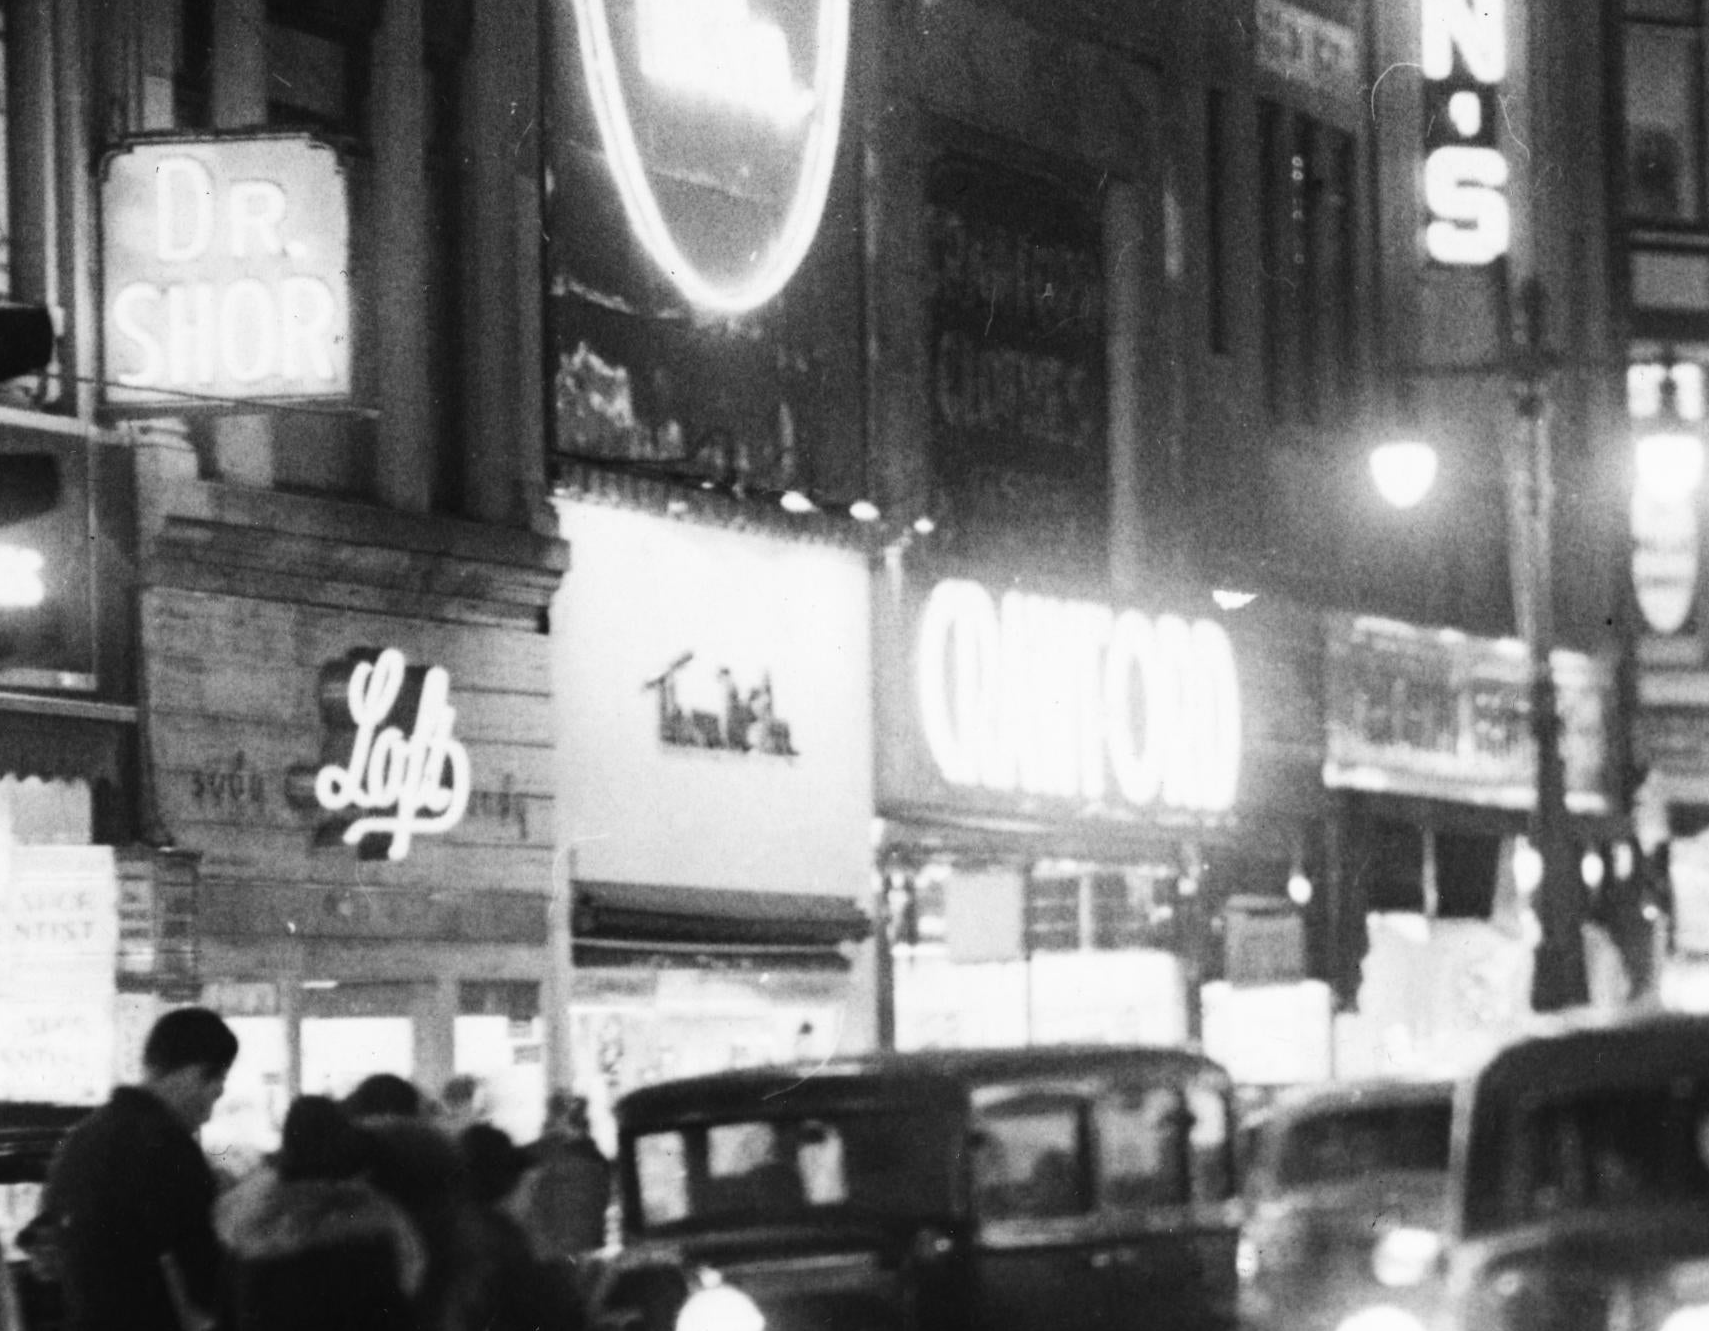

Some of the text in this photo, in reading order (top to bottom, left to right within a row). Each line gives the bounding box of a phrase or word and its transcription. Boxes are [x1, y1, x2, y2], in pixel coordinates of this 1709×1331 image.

[153, 153, 309, 263] DR.
[110, 276, 337, 387] SHOR
[314, 648, 471, 861] Loft
